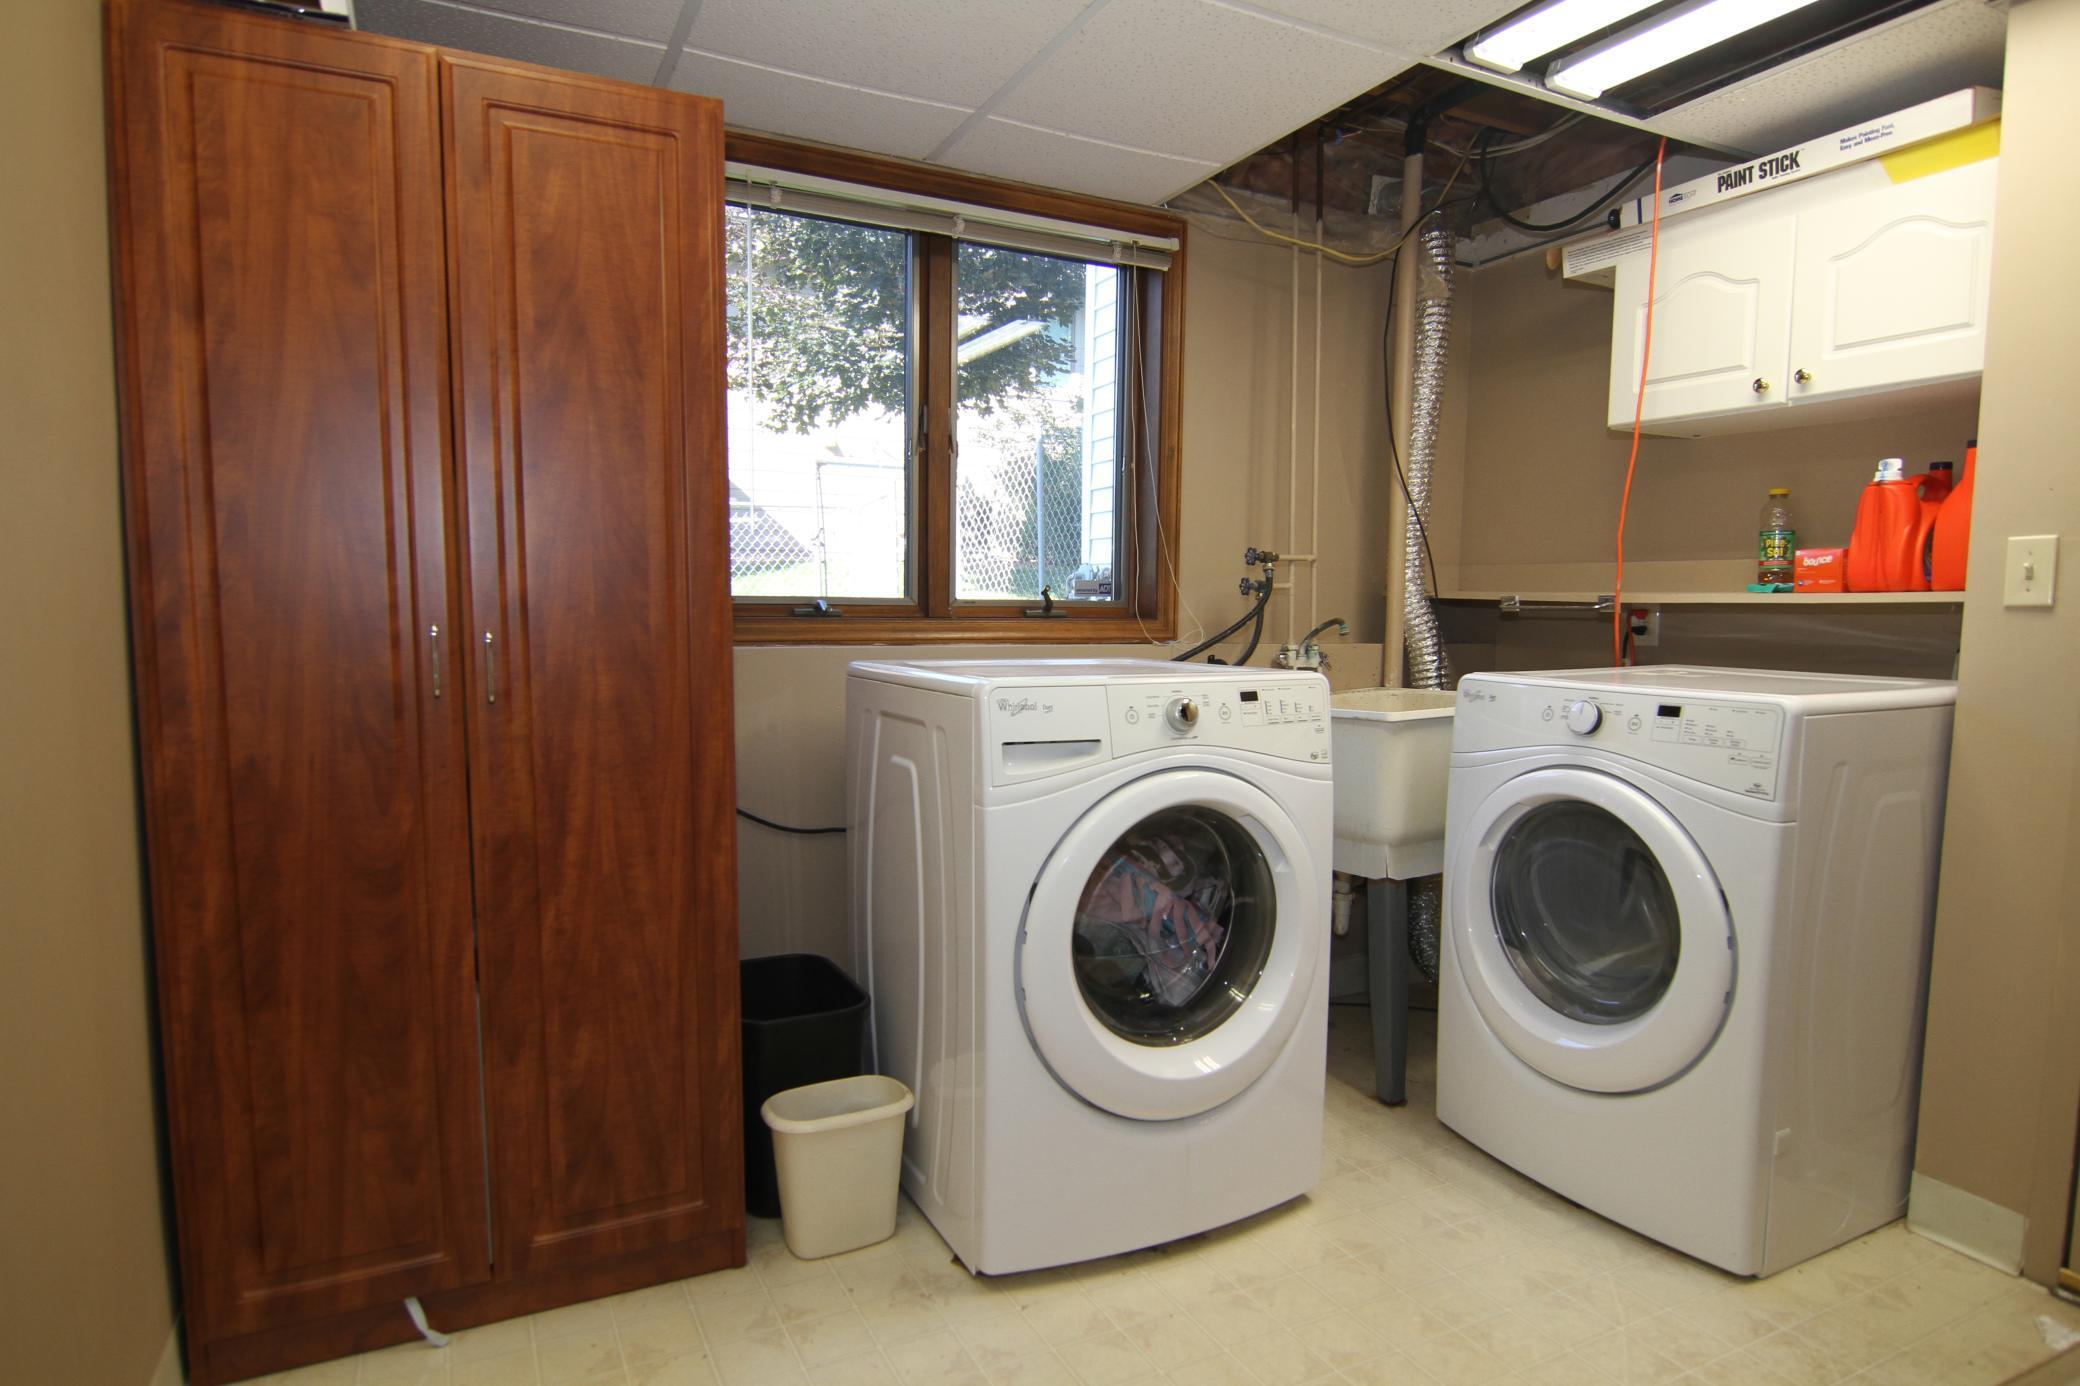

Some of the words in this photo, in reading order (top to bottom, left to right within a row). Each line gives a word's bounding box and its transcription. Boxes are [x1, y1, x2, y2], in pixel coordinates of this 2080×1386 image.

[1840, 135, 1857, 144] Makes
[1858, 127, 1881, 138] Painting
[1840, 143, 1852, 151] Easy
[1853, 138, 1864, 147] and
[1717, 165, 1755, 193] PAINT
[1758, 149, 1801, 180] STICK
[1099, 584, 1111, 593] ADT
